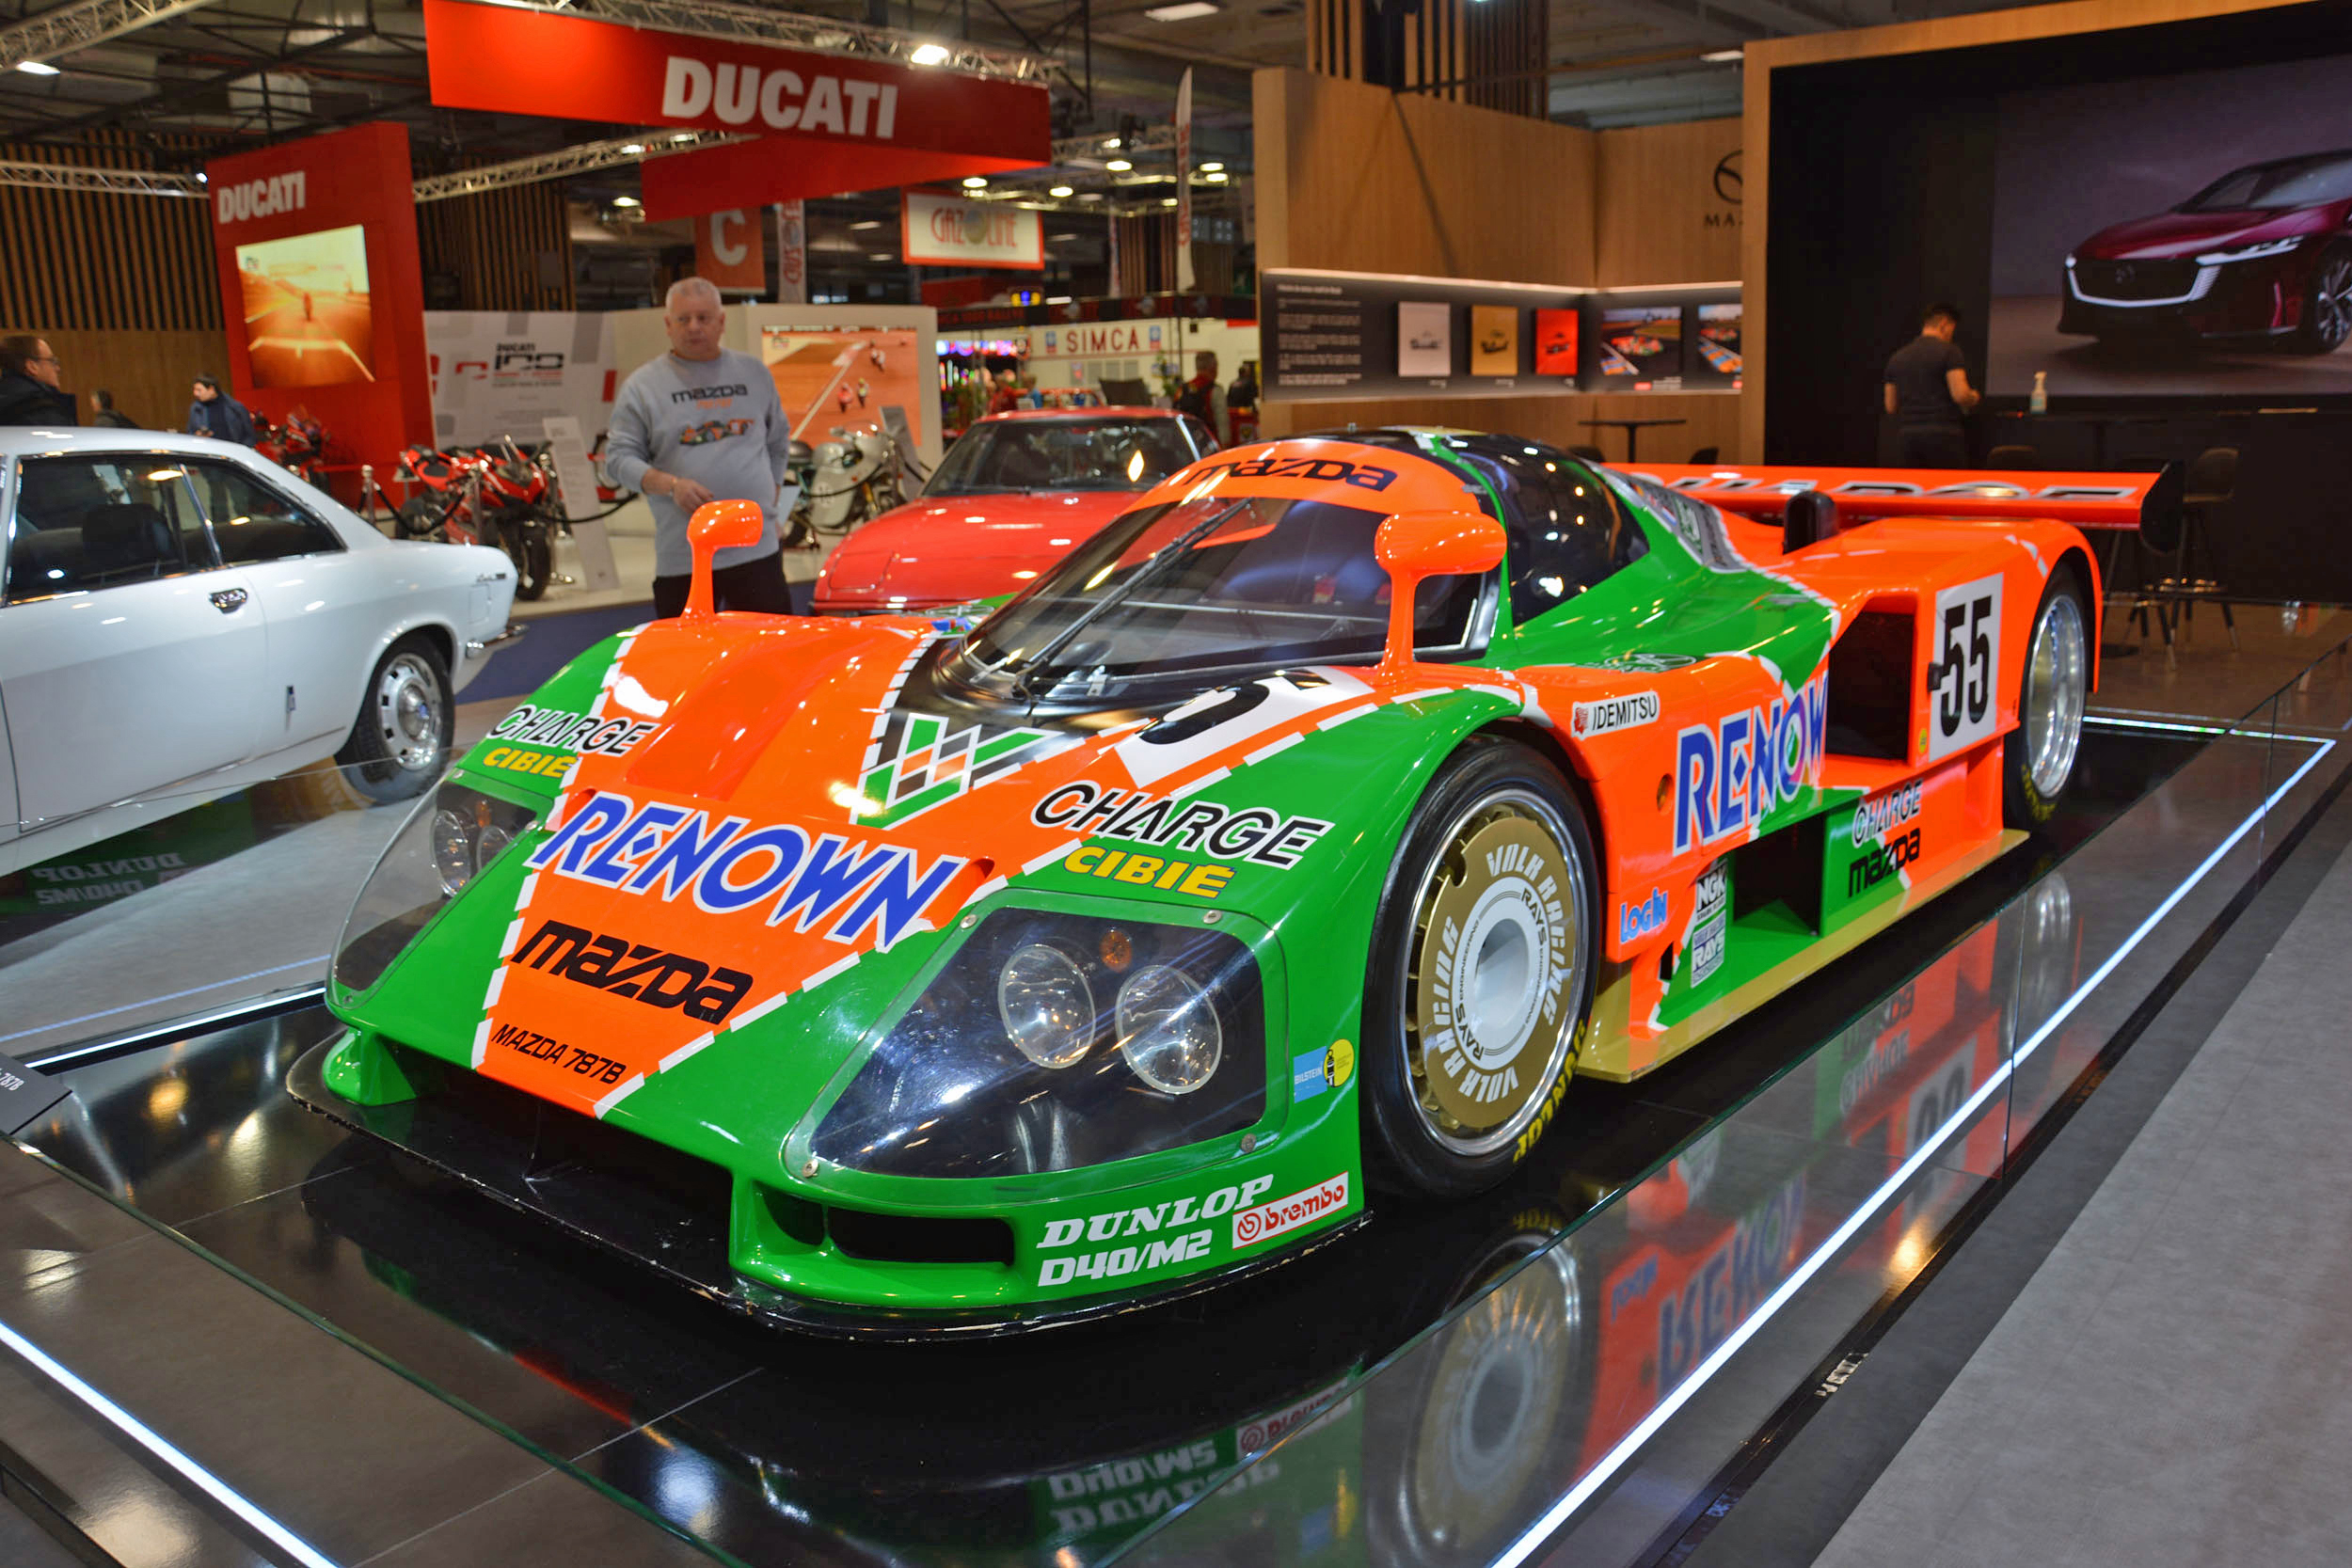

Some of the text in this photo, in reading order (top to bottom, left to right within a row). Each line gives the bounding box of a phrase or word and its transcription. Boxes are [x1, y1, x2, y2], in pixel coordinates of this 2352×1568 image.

[661, 55, 898, 138] DUCATI
[217, 170, 307, 225] DUCATI
[1066, 329, 1140, 352] SIMCA
[1181, 458, 1399, 493] mazda
[1940, 594, 1993, 737] 55
[486, 704, 661, 757] CHARGE
[1592, 694, 1658, 731] IDEMITSU
[1030, 780, 1336, 871] CHARGE
[1851, 777, 1923, 848] CHARGE
[522, 790, 969, 954] RENOWN
[1486, 843, 1545, 882] VOLK
[1696, 864, 1727, 912] NGK
[1848, 827, 1921, 898] mazda
[1520, 887, 1548, 946] RAYS
[510, 920, 754, 1025] mazda
[491, 1023, 627, 1085] MAZDA 787B
[1454, 1002, 1485, 1061] RAYS
[1458, 1066, 1519, 1103] VOLK
[1036, 1173, 1274, 1249] DUNLOP
[1265, 1182, 1345, 1232] brembo
[1038, 1228, 1213, 1287] D40/M2
